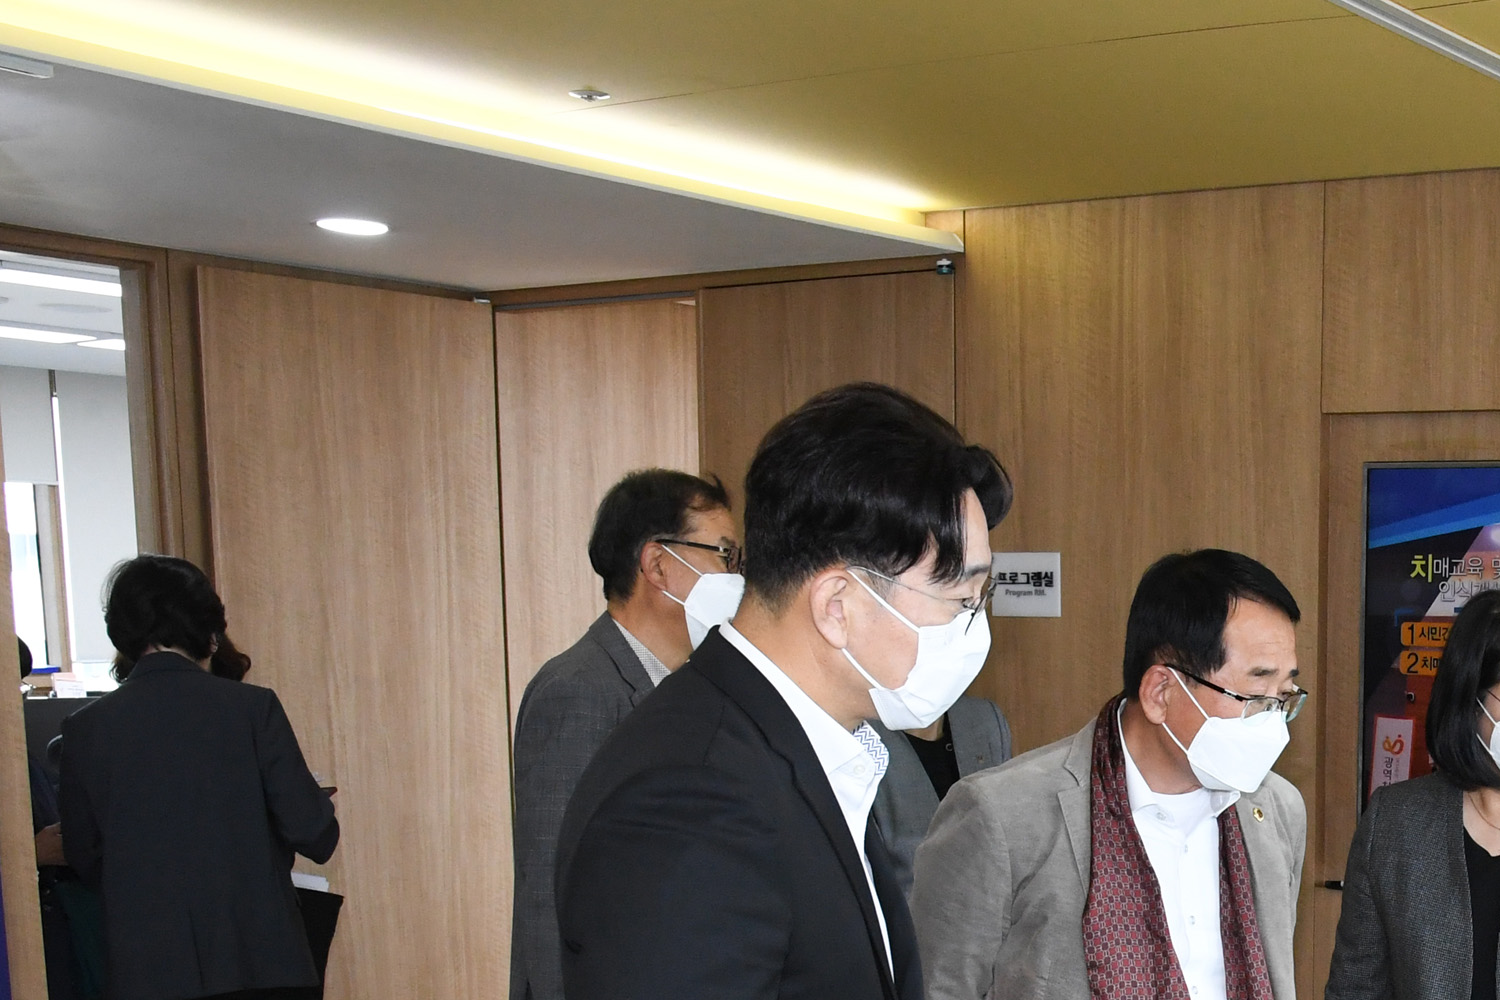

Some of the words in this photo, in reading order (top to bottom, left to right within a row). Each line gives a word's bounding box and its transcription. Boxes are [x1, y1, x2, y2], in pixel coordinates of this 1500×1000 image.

[1410, 553, 1484, 583] 치매교육
[997, 571, 1054, 588] 프로그램실
[1005, 589, 1033, 597] Program
[1408, 623, 1415, 645] 1
[1407, 652, 1419, 674] 2
